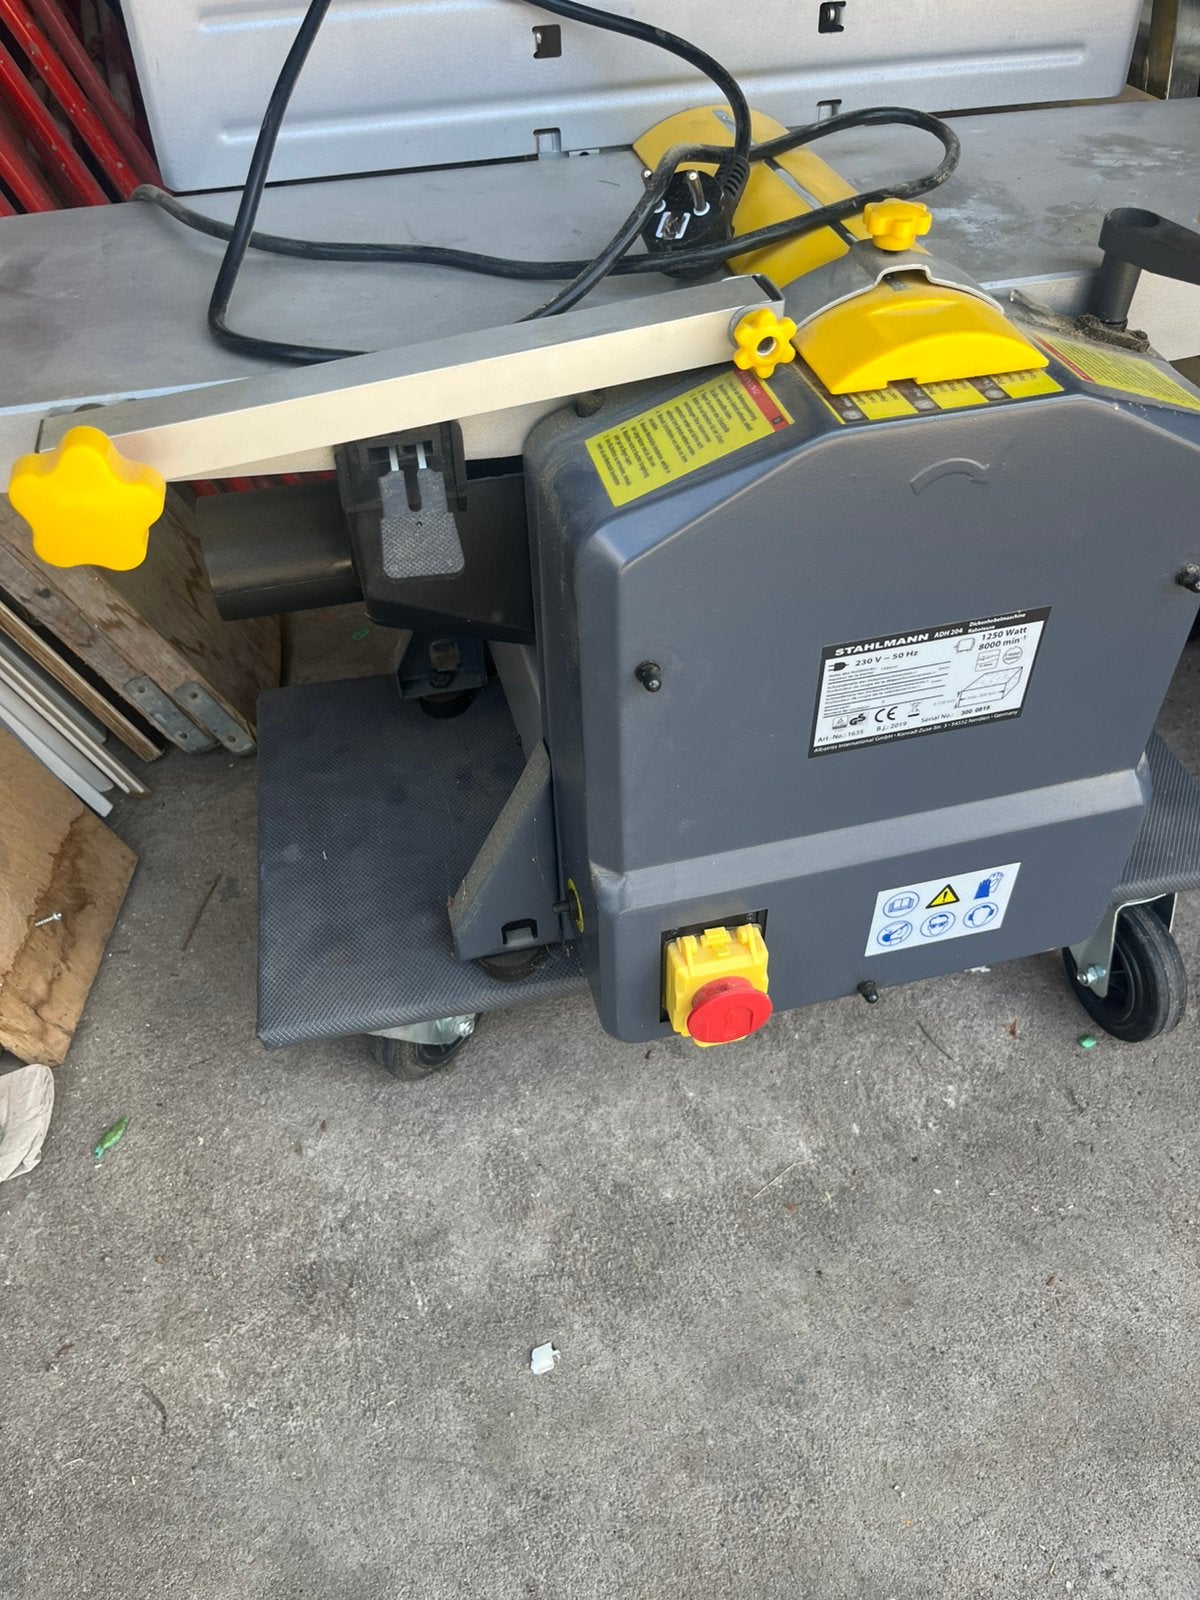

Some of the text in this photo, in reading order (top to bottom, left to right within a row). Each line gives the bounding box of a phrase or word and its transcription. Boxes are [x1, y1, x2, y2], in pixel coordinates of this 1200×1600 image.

[835, 626, 962, 656] STAHLMANN ADH 204
[982, 627, 1028, 641] 1250 Watt
[978, 640, 1001, 651] 8000
[855, 658, 873, 667] 230
[893, 652, 904, 660] 50
[906, 650, 919, 658] Hz
[849, 713, 866, 726] GS
[874, 706, 898, 723] CE
[921, 714, 940, 724] Serial
[941, 712, 955, 720] No.:
[814, 744, 838, 753] Albatros
[838, 737, 874, 749] International
[875, 733, 893, 742] GmbH
[994, 710, 1019, 719] Germany
[890, 721, 907, 729] 2019
[817, 729, 864, 743] Art.-No.: 1635
